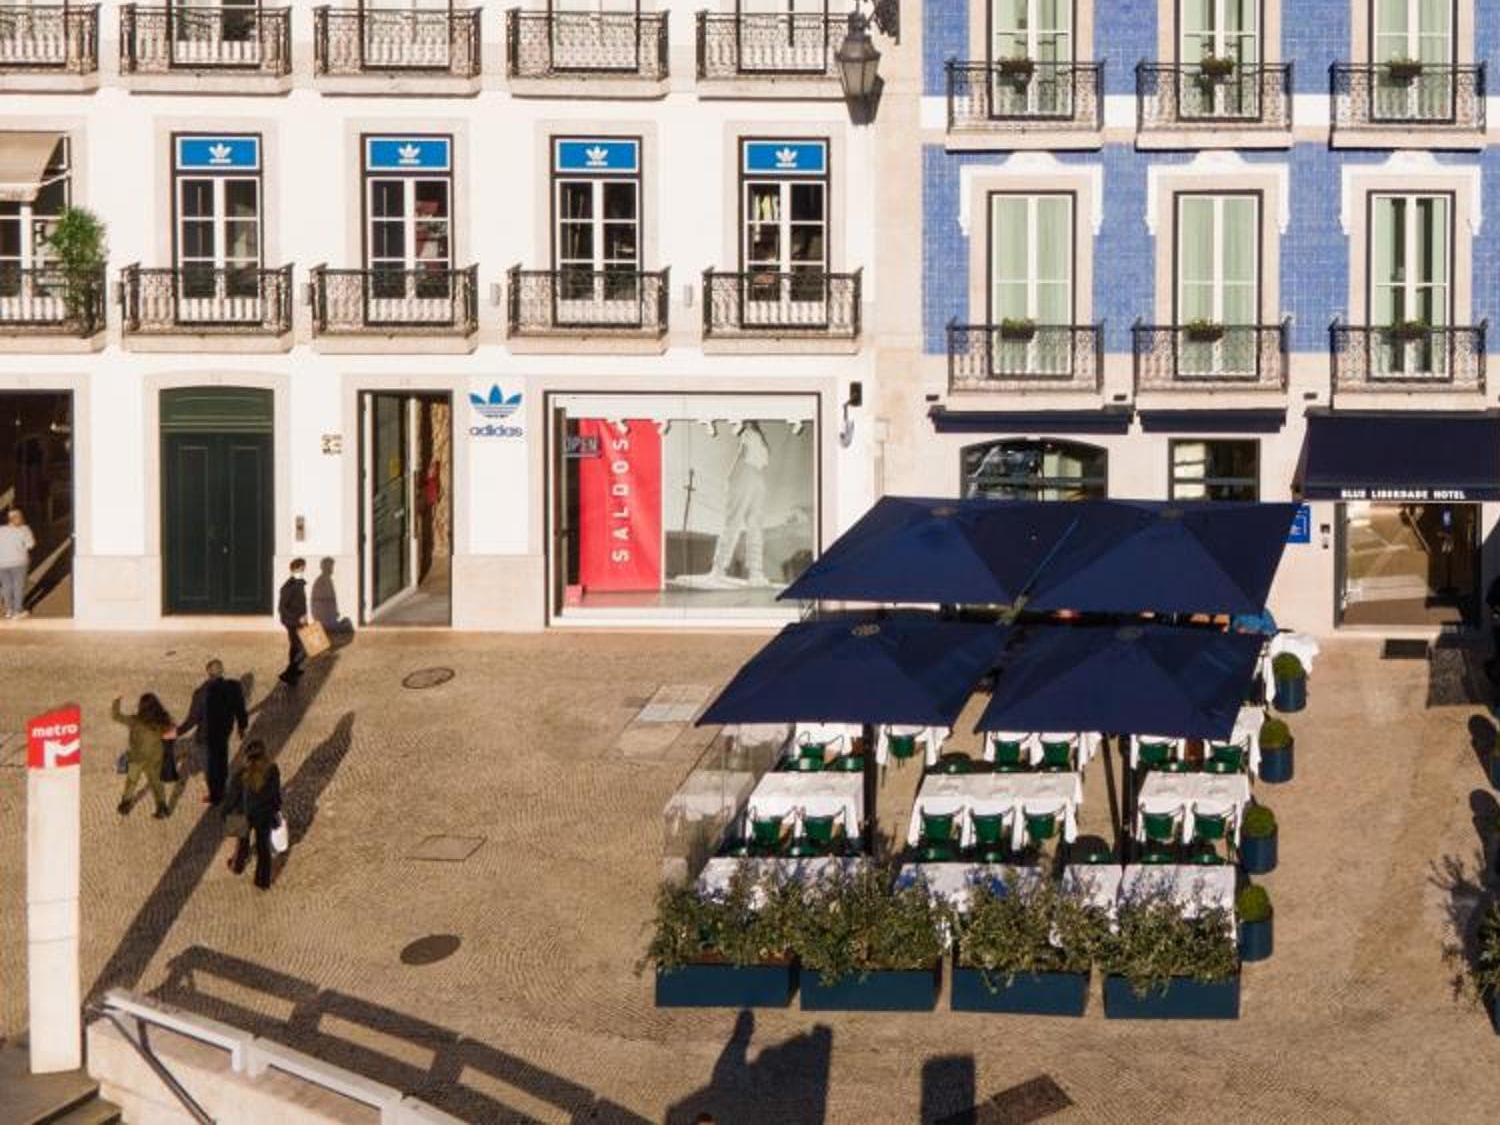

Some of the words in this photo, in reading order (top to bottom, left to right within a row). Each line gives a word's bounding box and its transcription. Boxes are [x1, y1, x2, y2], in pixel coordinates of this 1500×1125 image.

[469, 424, 523, 437] adidas
[611, 439, 629, 562] SALDOS
[1341, 490, 1366, 499] BLUE
[1371, 490, 1428, 499] LIBERDADE
[1433, 490, 1466, 499] HOTEL
[32, 723, 78, 737] metro
